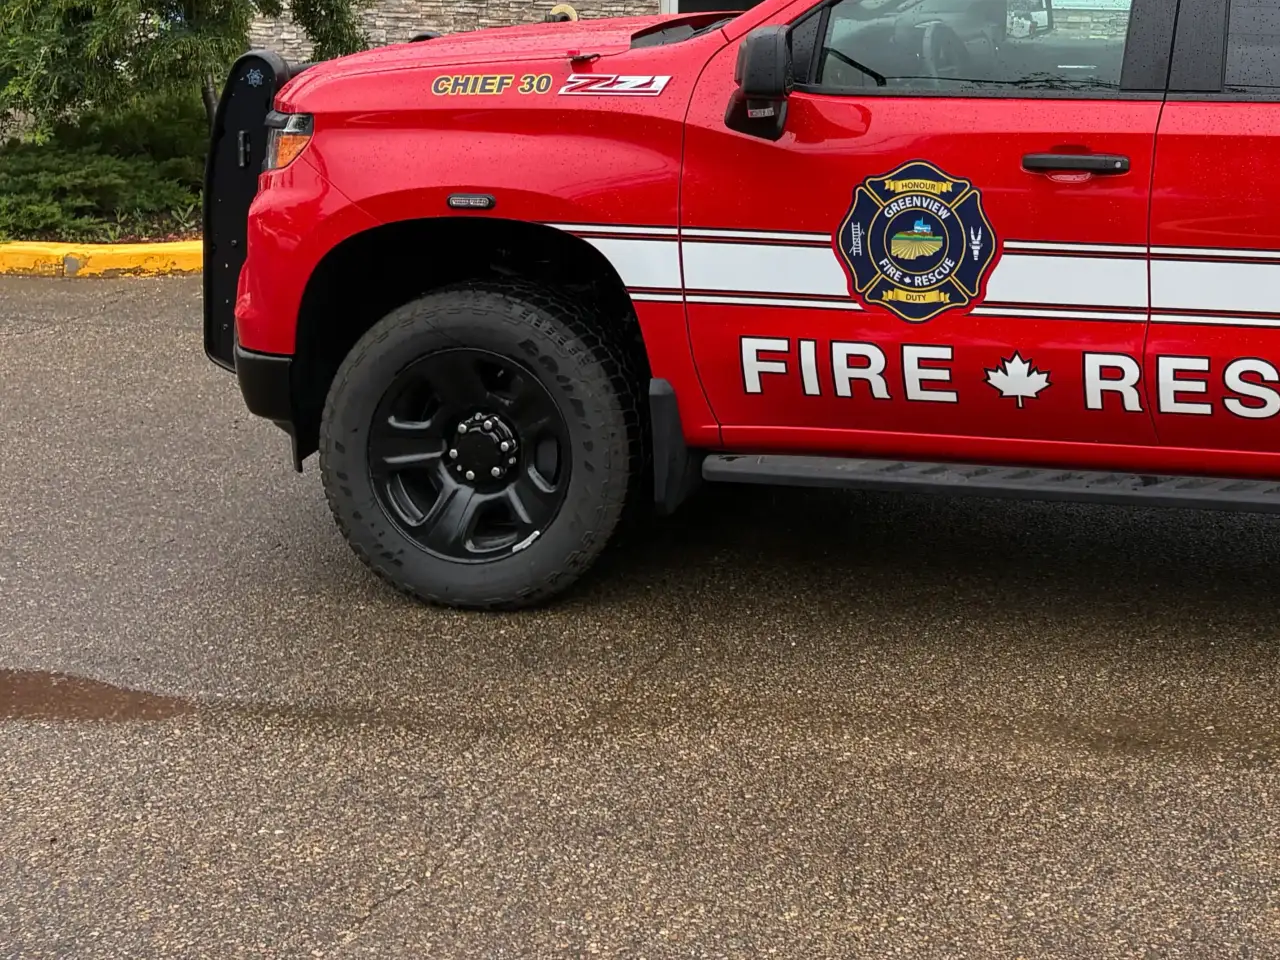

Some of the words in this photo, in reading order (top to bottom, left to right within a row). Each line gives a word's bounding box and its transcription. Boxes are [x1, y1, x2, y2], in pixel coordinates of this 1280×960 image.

[431, 74, 515, 96] CHIEF
[518, 73, 553, 95] 30
[901, 181, 937, 191] HONOUR
[884, 196, 951, 221] GREENVIEW
[878, 258, 902, 283] FIRE
[914, 257, 956, 287] RESCUE
[905, 293, 927, 302] DUTY
[740, 335, 960, 405] FIRE
